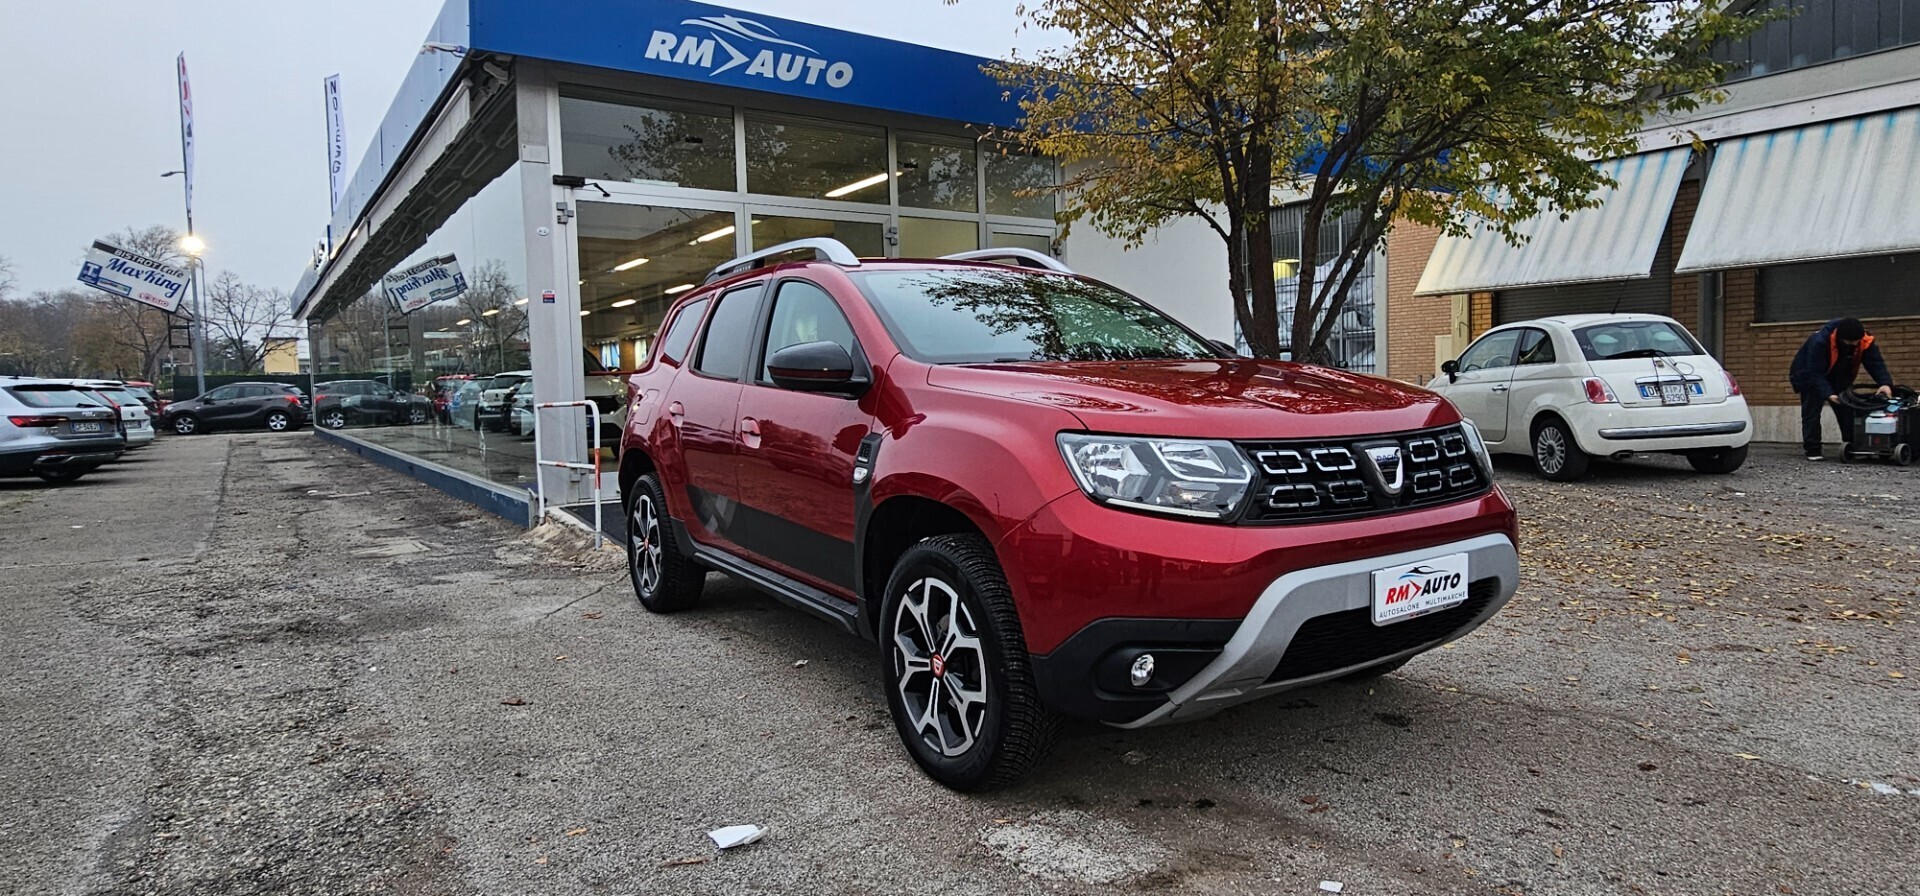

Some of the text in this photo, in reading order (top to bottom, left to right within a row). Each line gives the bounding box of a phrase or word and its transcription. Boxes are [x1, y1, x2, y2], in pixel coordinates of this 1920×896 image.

[644, 30, 854, 88] RM AUTO
[114, 249, 160, 269] BISTROT
[1385, 572, 1461, 605] RM AUTO
[1379, 602, 1420, 618] AUTOSALONE
[1425, 591, 1466, 606] MULTIMARCHE
